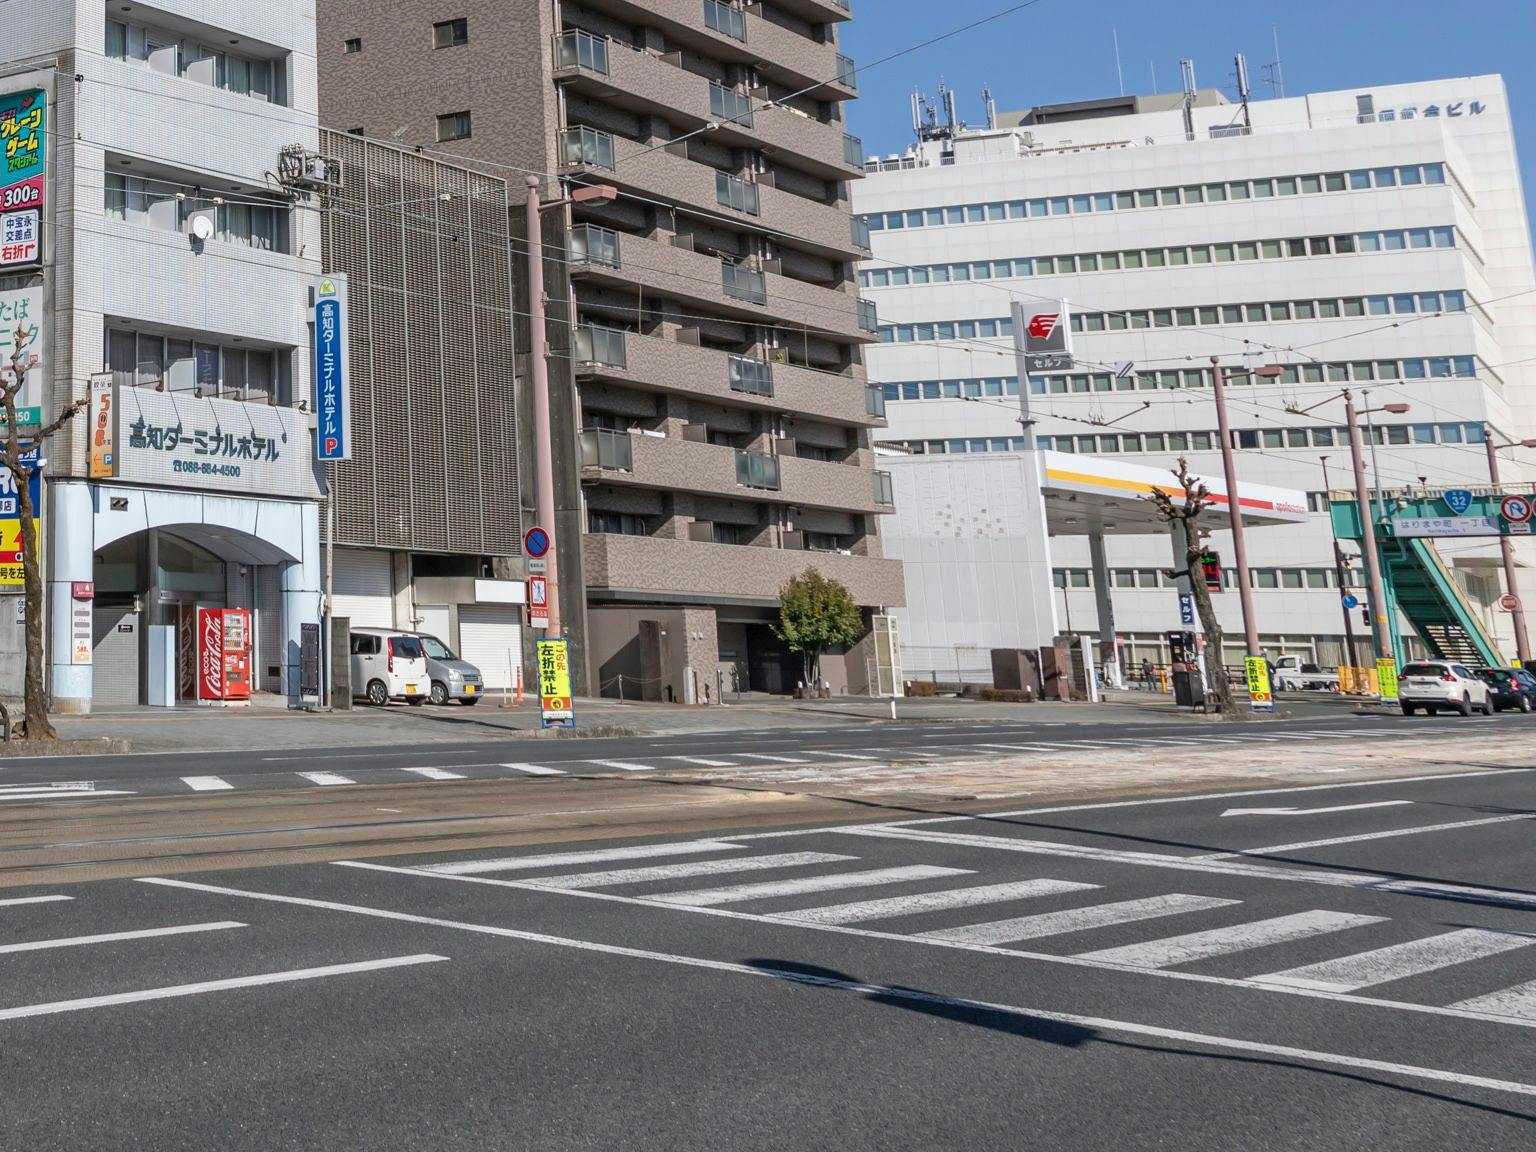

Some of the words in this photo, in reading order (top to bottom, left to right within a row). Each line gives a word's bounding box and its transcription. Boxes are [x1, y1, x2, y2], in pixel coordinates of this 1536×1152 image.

[0, 108, 42, 138] クレーン
[6, 132, 38, 157] ゲーム
[4, 185, 38, 207] 300台
[6, 216, 32, 229] 中宝永
[6, 228, 32, 242] 交差点
[2, 244, 23, 260] 右折
[322, 304, 336, 435] 高知ターミナルホテル
[129, 423, 279, 462] 高知ターミナルホテル
[325, 438, 337, 455] P
[1452, 496, 1467, 506] 32
[1181, 597, 1192, 623] セルフ
[541, 644, 557, 695] 左折禁止
